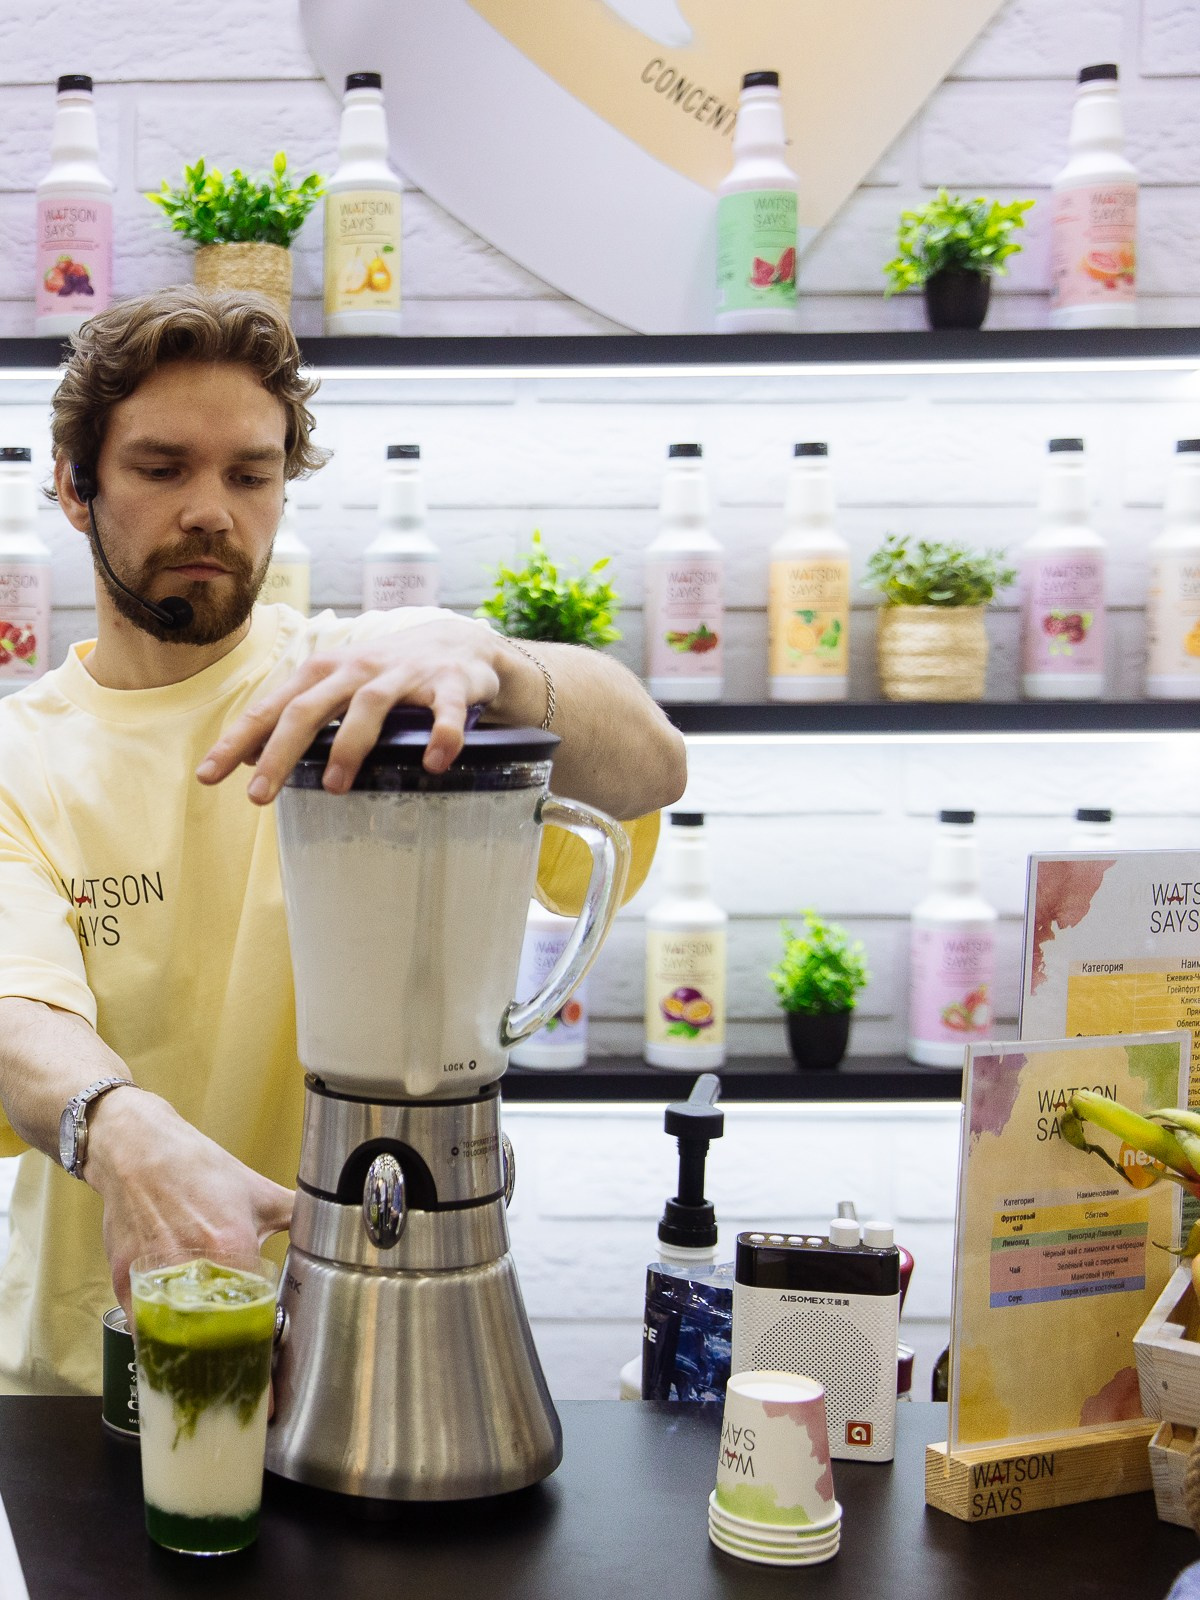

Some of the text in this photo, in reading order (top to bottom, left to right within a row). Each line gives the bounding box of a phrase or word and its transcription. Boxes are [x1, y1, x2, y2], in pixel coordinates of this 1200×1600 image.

[640, 57, 738, 137] CONCENT
[44, 207, 97, 223] WATSON
[340, 201, 393, 216] WATSON
[44, 223, 75, 239] SAYS
[340, 216, 376, 233] SAYS
[373, 574, 425, 588] WATSON
[788, 567, 841, 582] WATSON
[1152, 882, 1200, 906] WATS
[1150, 909, 1200, 934] SAYS
[78, 915, 120, 947] AYS
[1082, 963, 1124, 974] Категория
[1176, 1019, 1200, 1028] Облепи
[443, 1062, 464, 1072] LOCK
[1003, 1188, 1119, 1206] Категория Наименование
[1001, 1211, 1109, 1224] Фруктовый Сбитень
[1012, 1223, 1023, 1232] чай
[1002, 1229, 1122, 1248] Лимонад Виноград-Лаванда
[1067, 1247, 1078, 1255] чай
[1083, 1245, 1110, 1254] лимоном
[1116, 1241, 1145, 1250] чабрецом
[1084, 1259, 1094, 1267] чай
[1100, 1256, 1129, 1266] персиком
[1009, 1265, 1021, 1274] Чай
[1071, 1270, 1115, 1281] Манговый улун
[779, 1294, 826, 1305] AISOMEX
[1008, 1294, 1023, 1304] Соус
[1060, 1286, 1089, 1296] Маракуйя
[1095, 1280, 1125, 1292] косточкой
[973, 1454, 1055, 1489] WATSON
[972, 1487, 1023, 1518] SAYS
